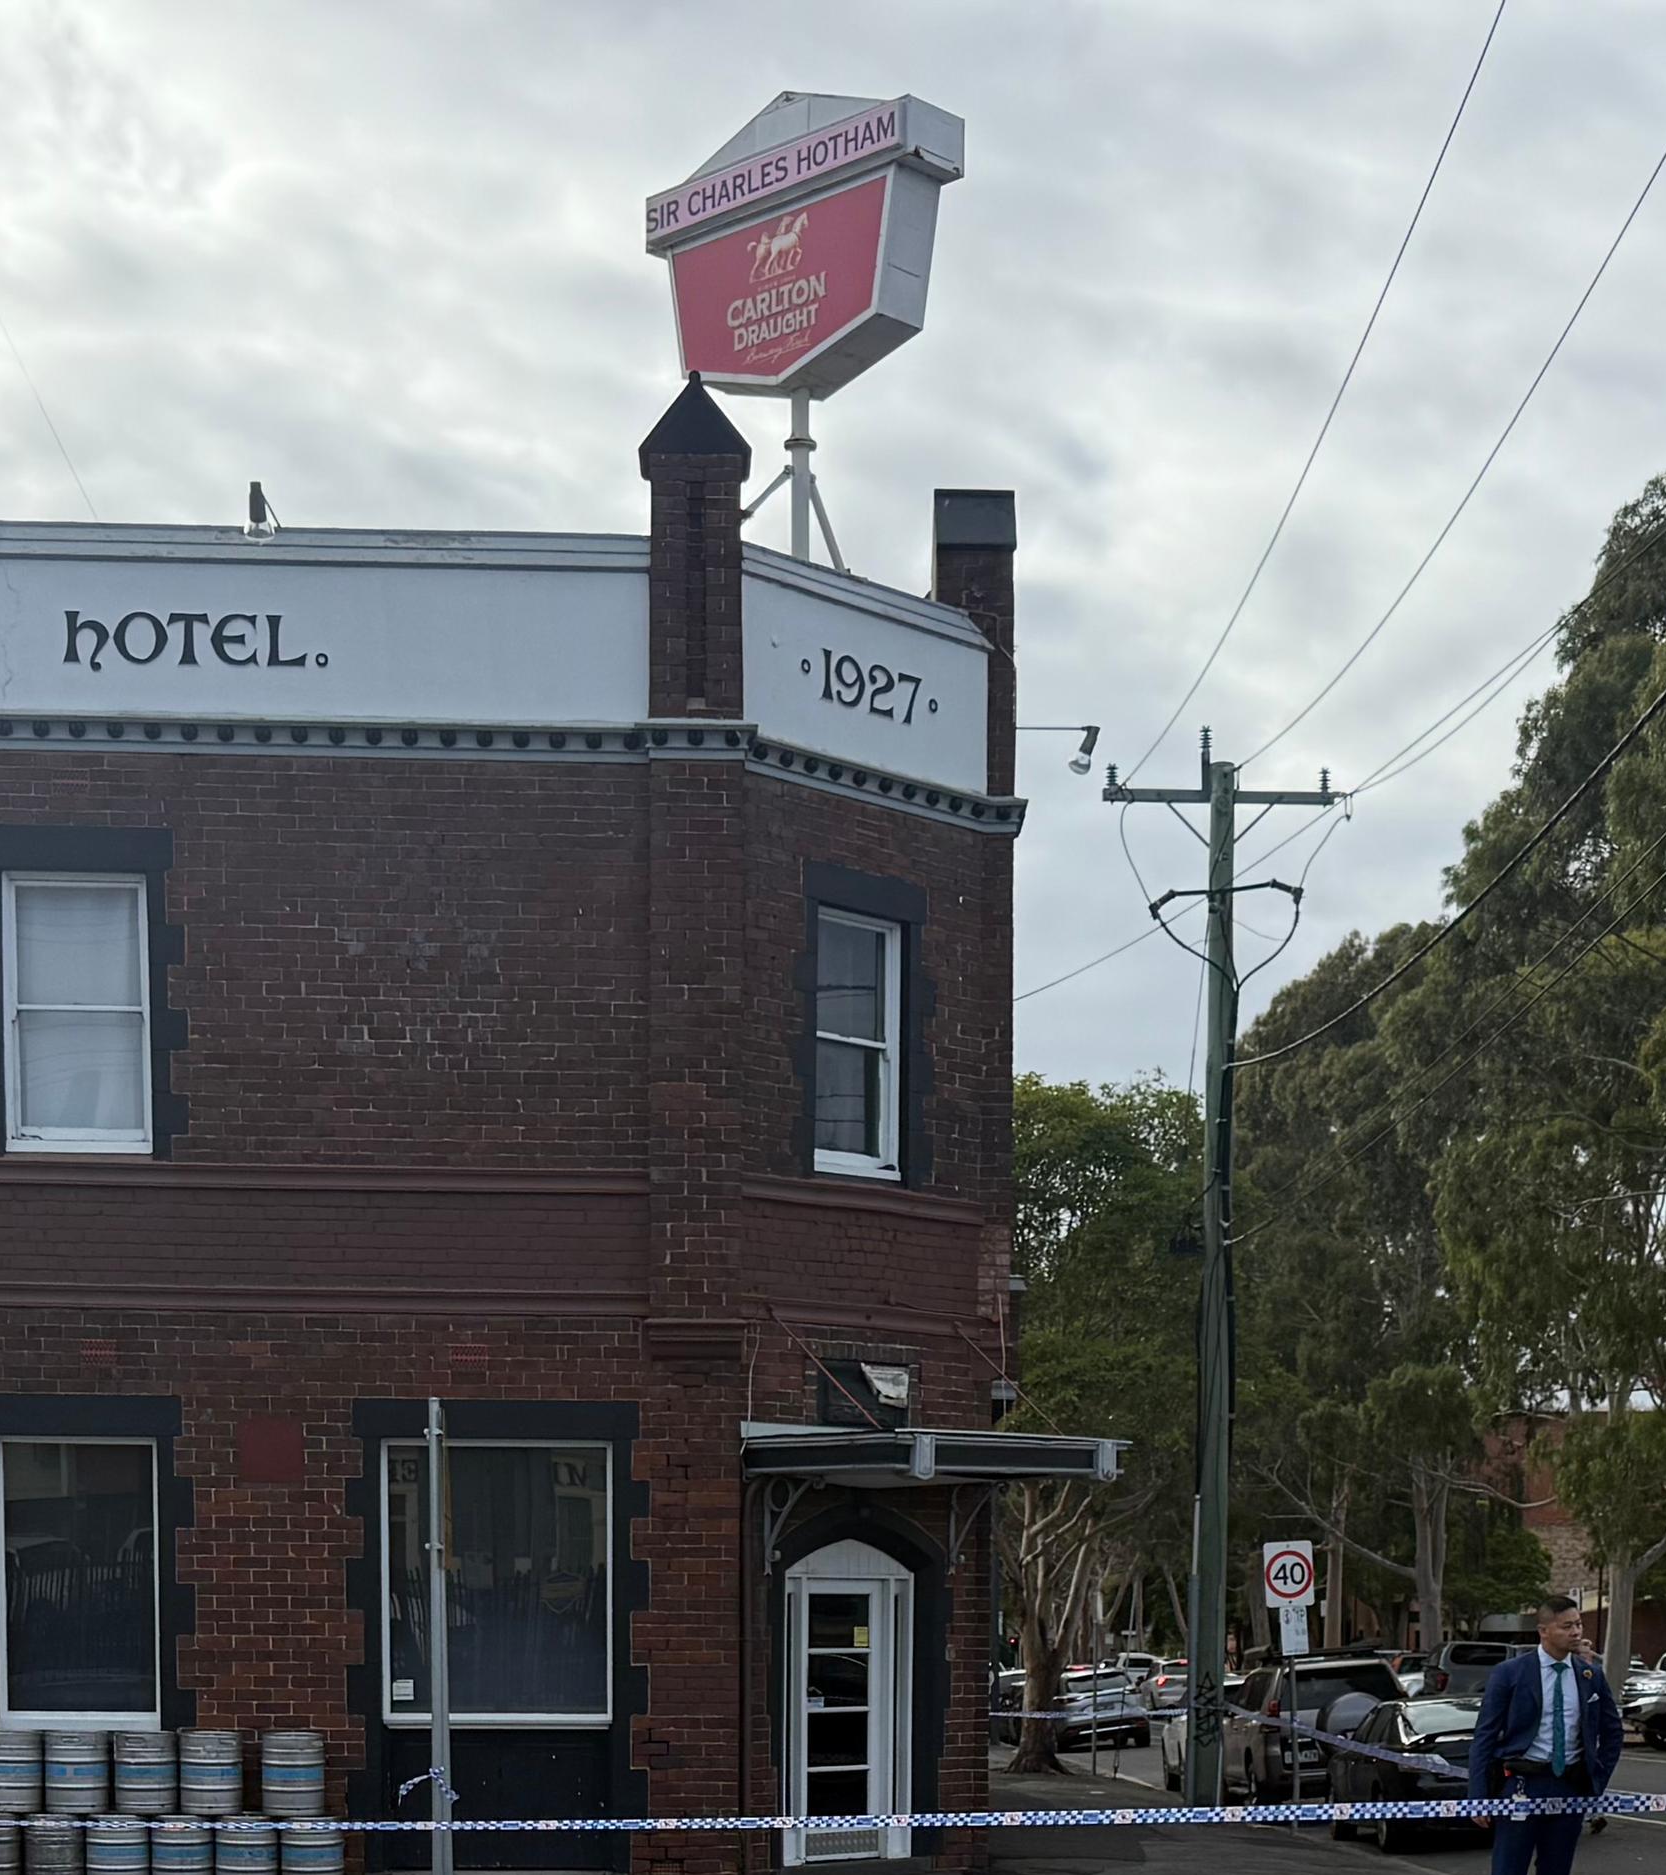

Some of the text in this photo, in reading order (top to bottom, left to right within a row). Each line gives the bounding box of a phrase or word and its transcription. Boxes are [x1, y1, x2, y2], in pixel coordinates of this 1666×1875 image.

[646, 110, 896, 234] SIR CHARLES HOTHAM
[726, 271, 826, 328] CARLTON
[733, 303, 819, 352] DRAUGHT
[819, 647, 923, 726] 1927
[1273, 1562, 1306, 1586] 40
